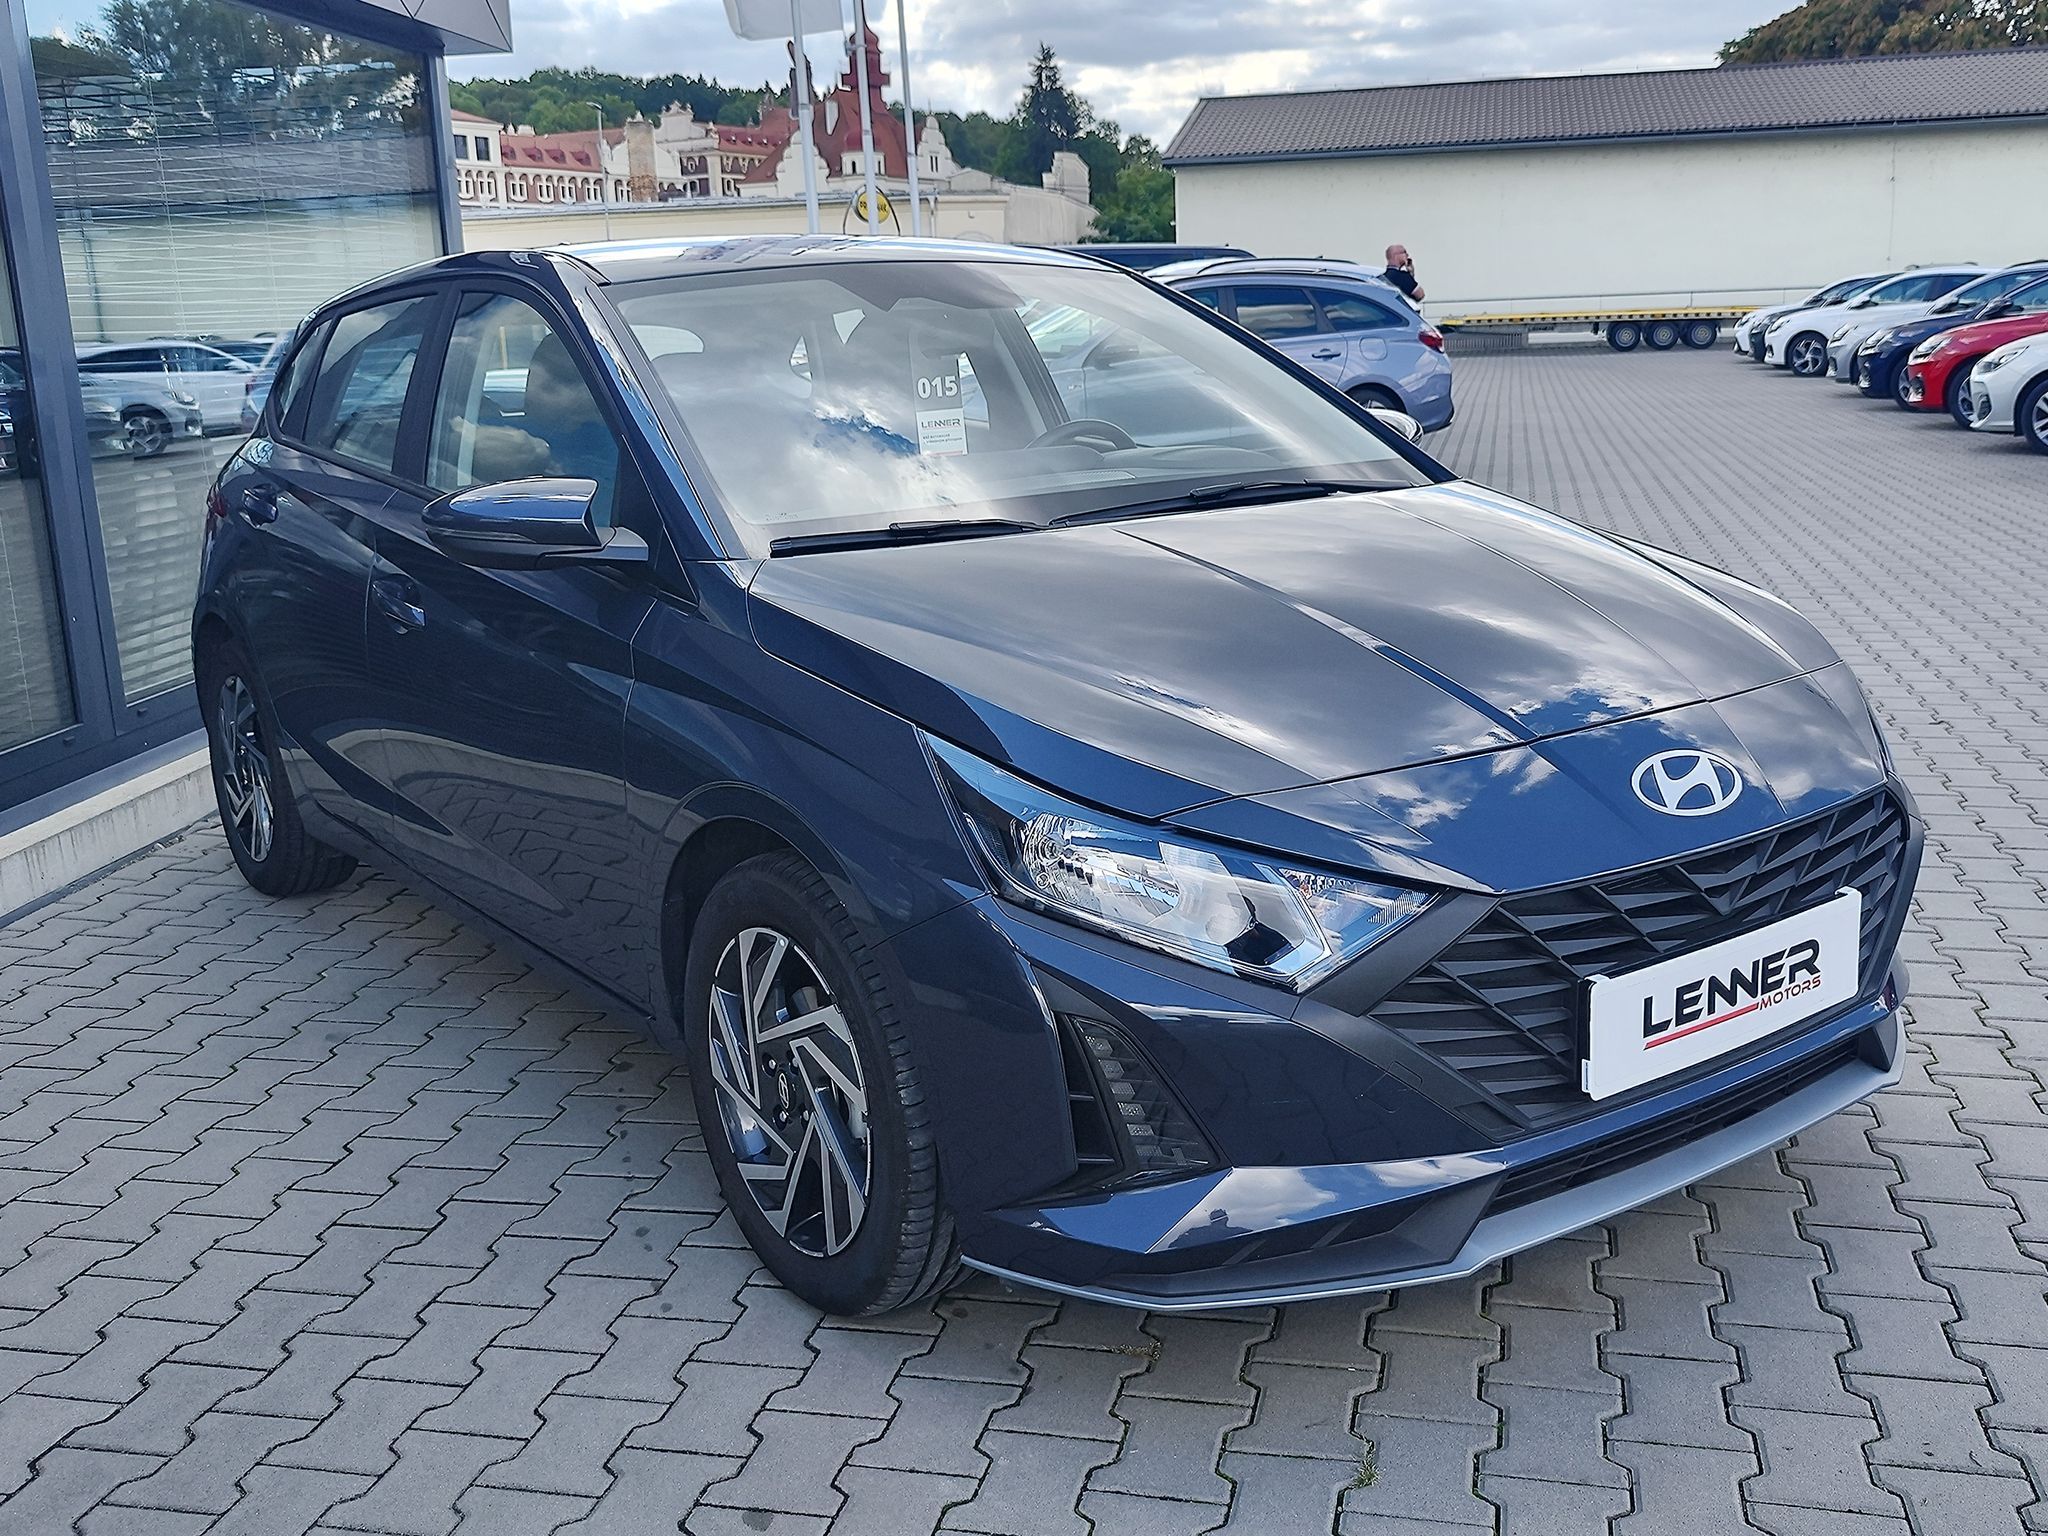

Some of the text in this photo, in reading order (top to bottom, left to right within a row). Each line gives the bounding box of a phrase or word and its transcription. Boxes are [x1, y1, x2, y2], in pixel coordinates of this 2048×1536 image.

[917, 375, 958, 399] 015
[921, 418, 961, 429] LENNER
[1643, 939, 1821, 1038] LENNER
[1759, 975, 1821, 1010] MOTORS
